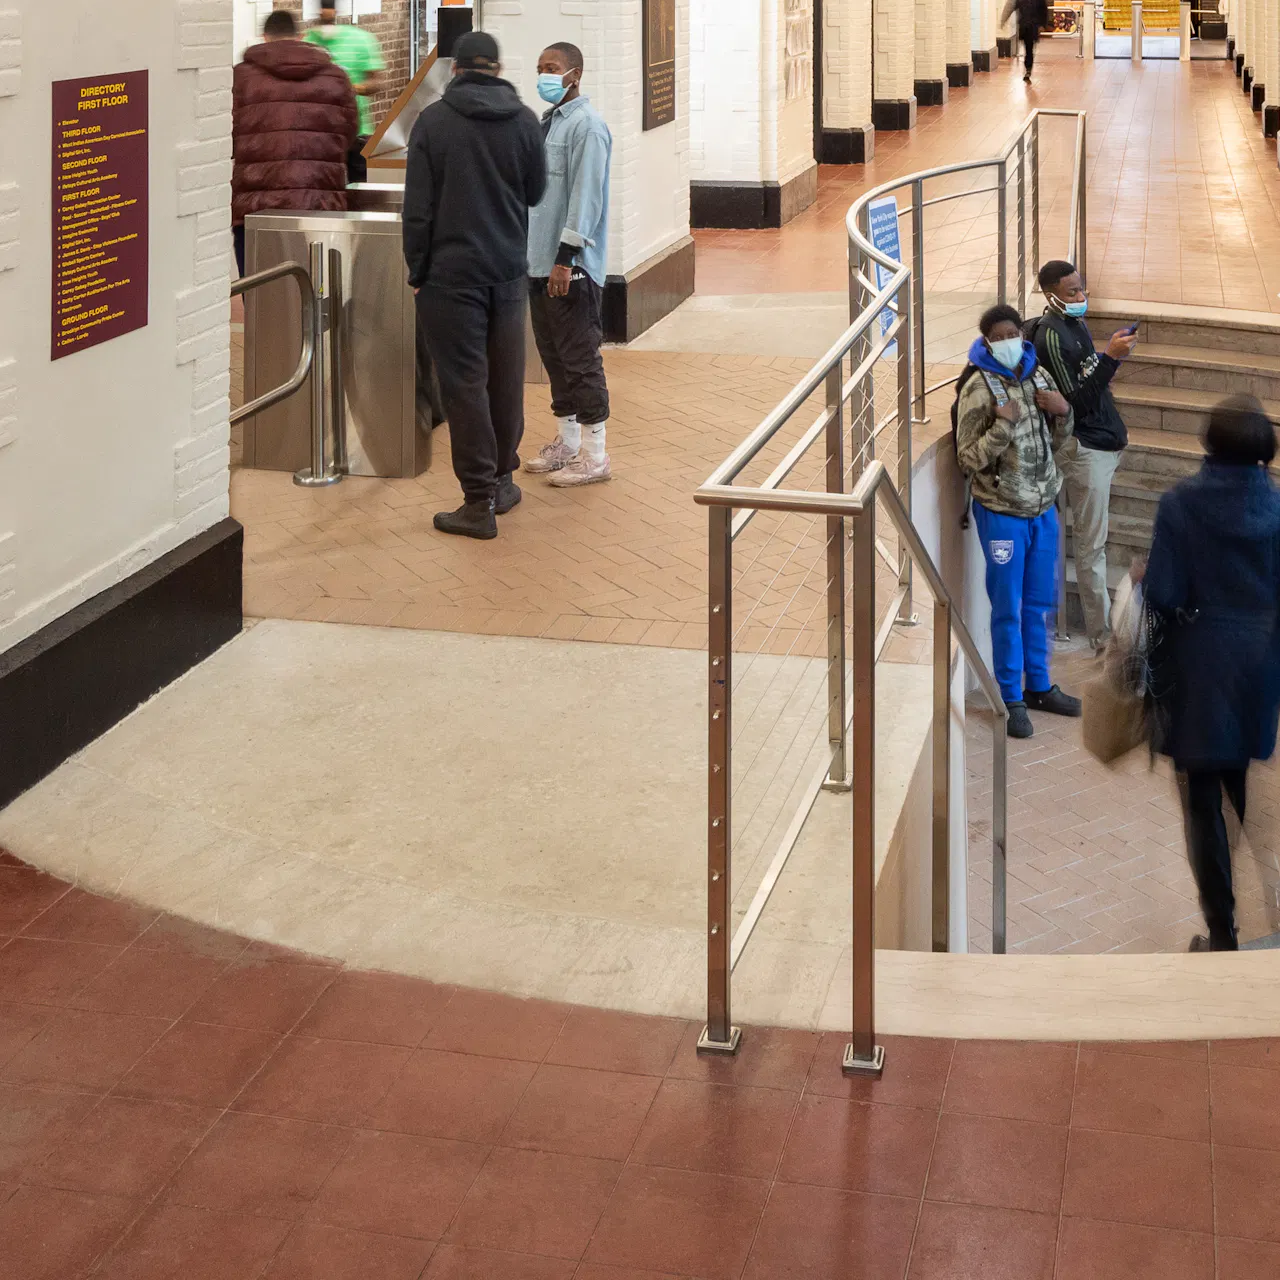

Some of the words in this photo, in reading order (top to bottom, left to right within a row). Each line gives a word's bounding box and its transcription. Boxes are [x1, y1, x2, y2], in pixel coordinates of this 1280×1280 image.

[81, 83, 125, 97] DIRECTORY
[78, 99, 101, 110] FIRST
[102, 95, 128, 107] FLOOR
[62, 129, 81, 138] THIRD
[81, 126, 101, 135] FLOOR
[62, 159, 87, 170] SECOND
[88, 155, 107, 164] FLOOR
[62, 192, 79, 202] FIRST
[80, 187, 100, 197] FLOOR
[62, 312, 88, 326] GROUND
[89, 305, 108, 317] FLOOR
